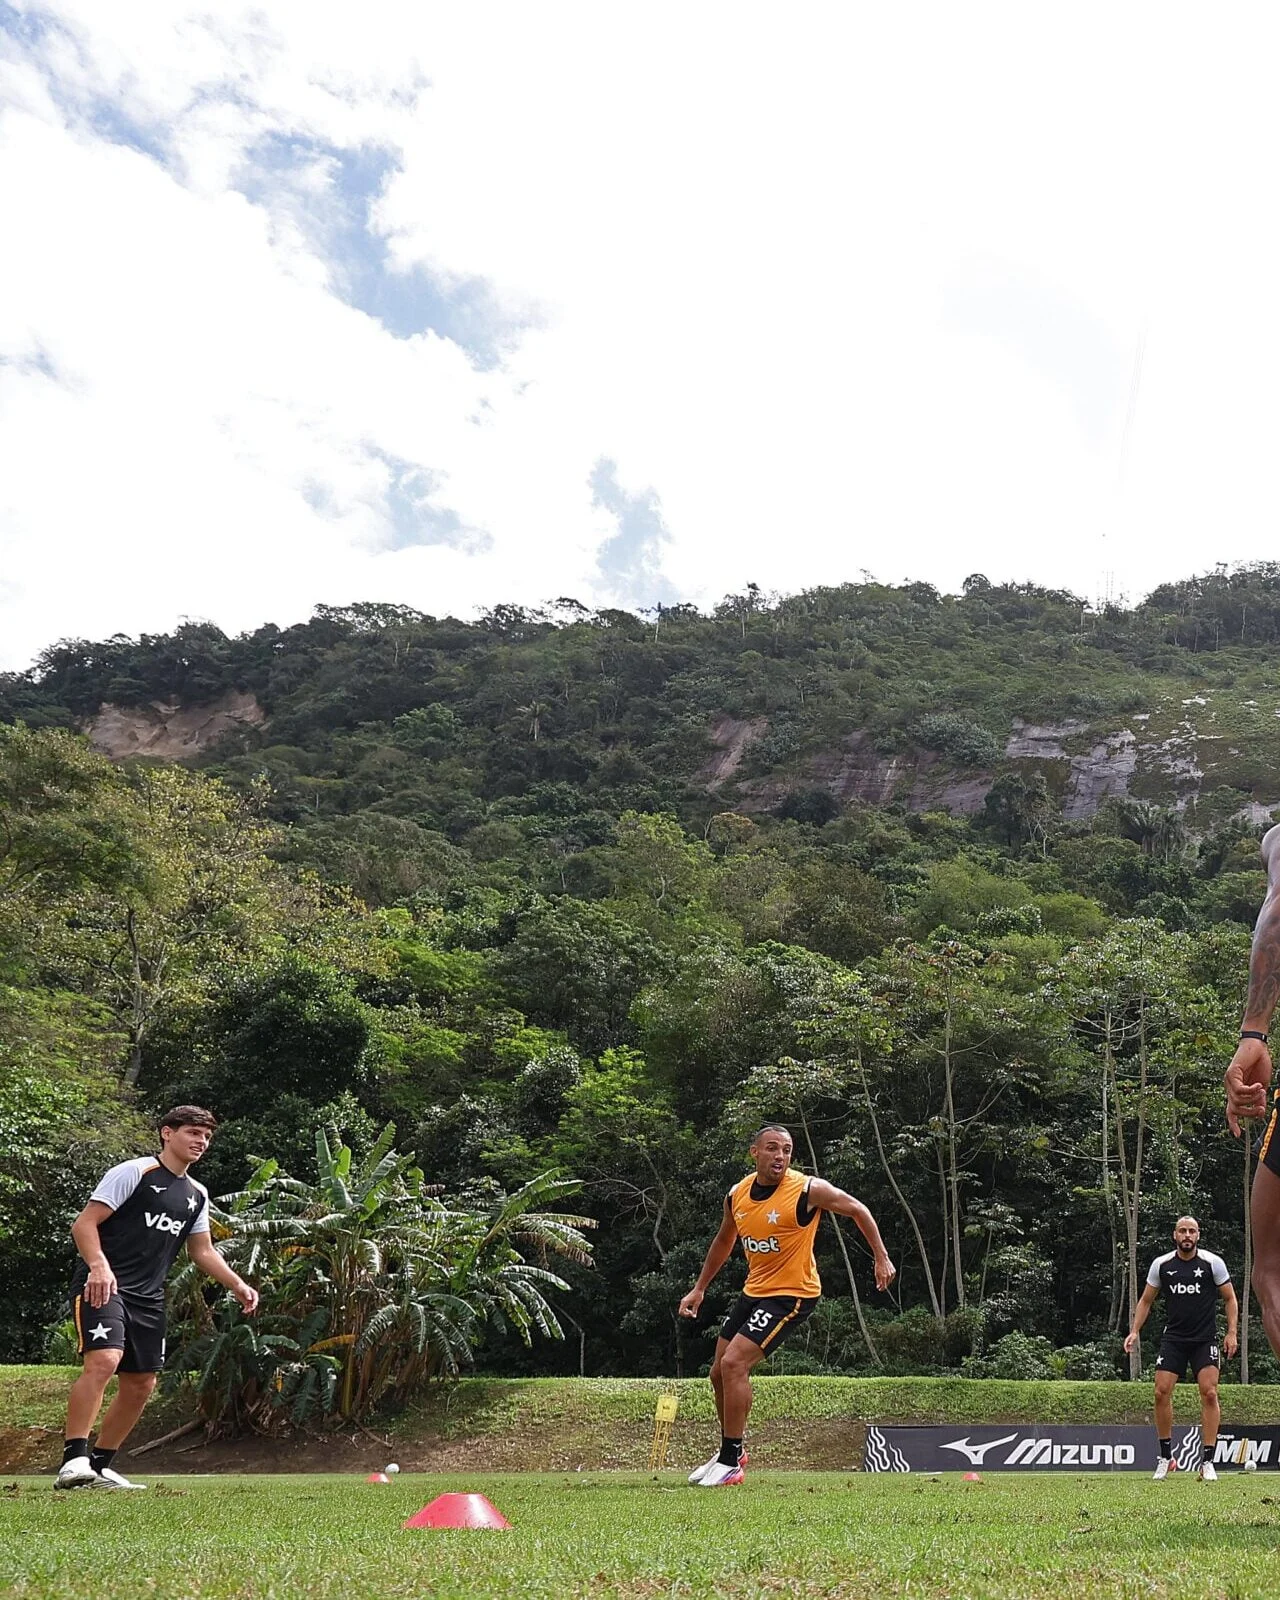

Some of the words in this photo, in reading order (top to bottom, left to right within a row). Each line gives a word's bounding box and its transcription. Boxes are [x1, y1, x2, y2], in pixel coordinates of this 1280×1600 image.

[1169, 1282, 1201, 1294] vbet
[750, 1308, 773, 1328] 55
[1210, 1345, 1218, 1356] 19
